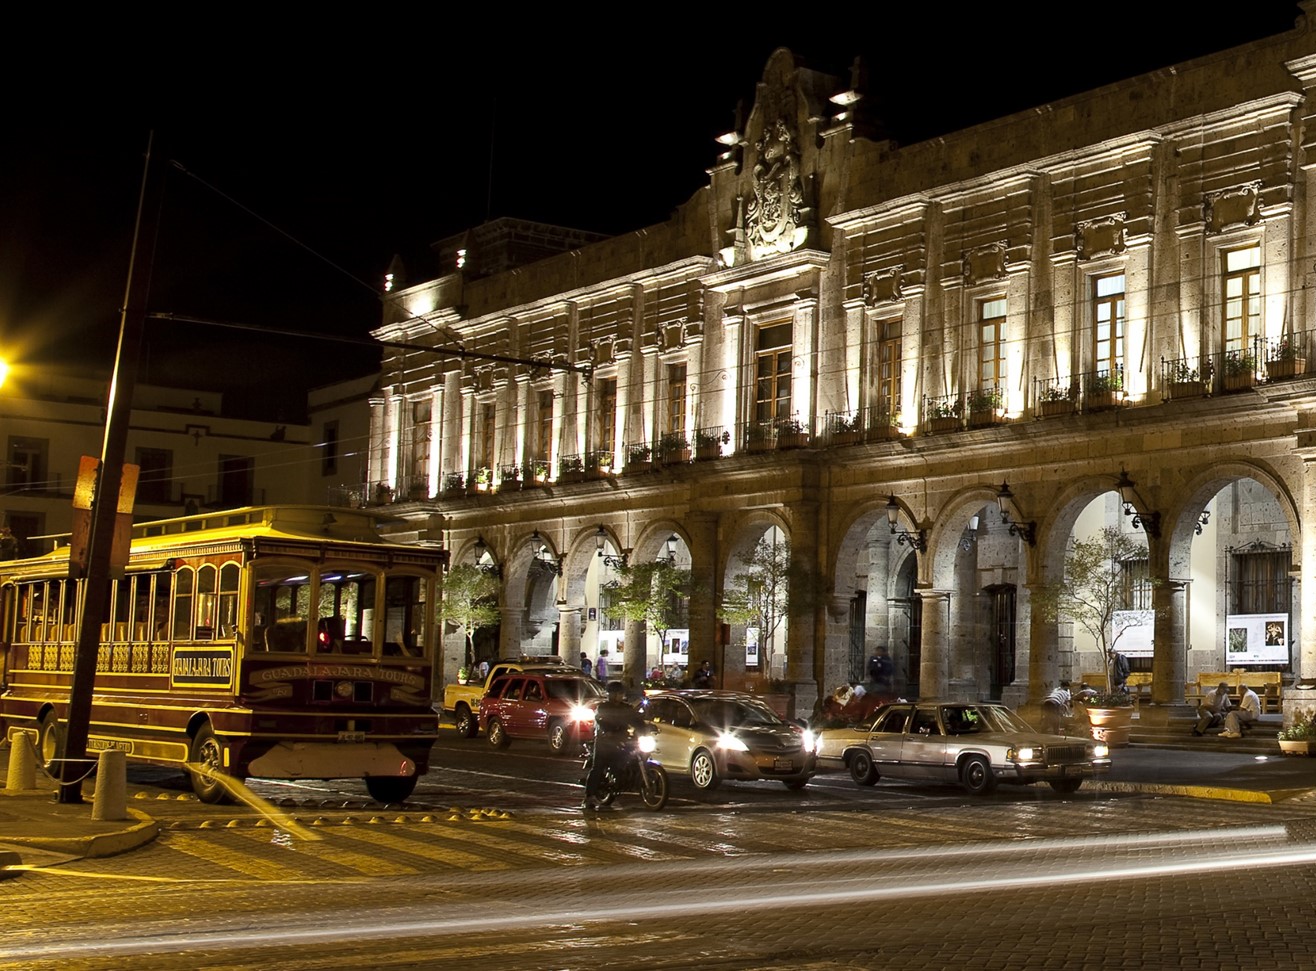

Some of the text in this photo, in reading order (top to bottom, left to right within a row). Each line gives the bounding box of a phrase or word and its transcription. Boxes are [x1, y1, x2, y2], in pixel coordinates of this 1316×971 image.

[174, 657, 231, 677] GUADALAJARA TOURS
[261, 666, 417, 686] GUADALAJARA TOURS
